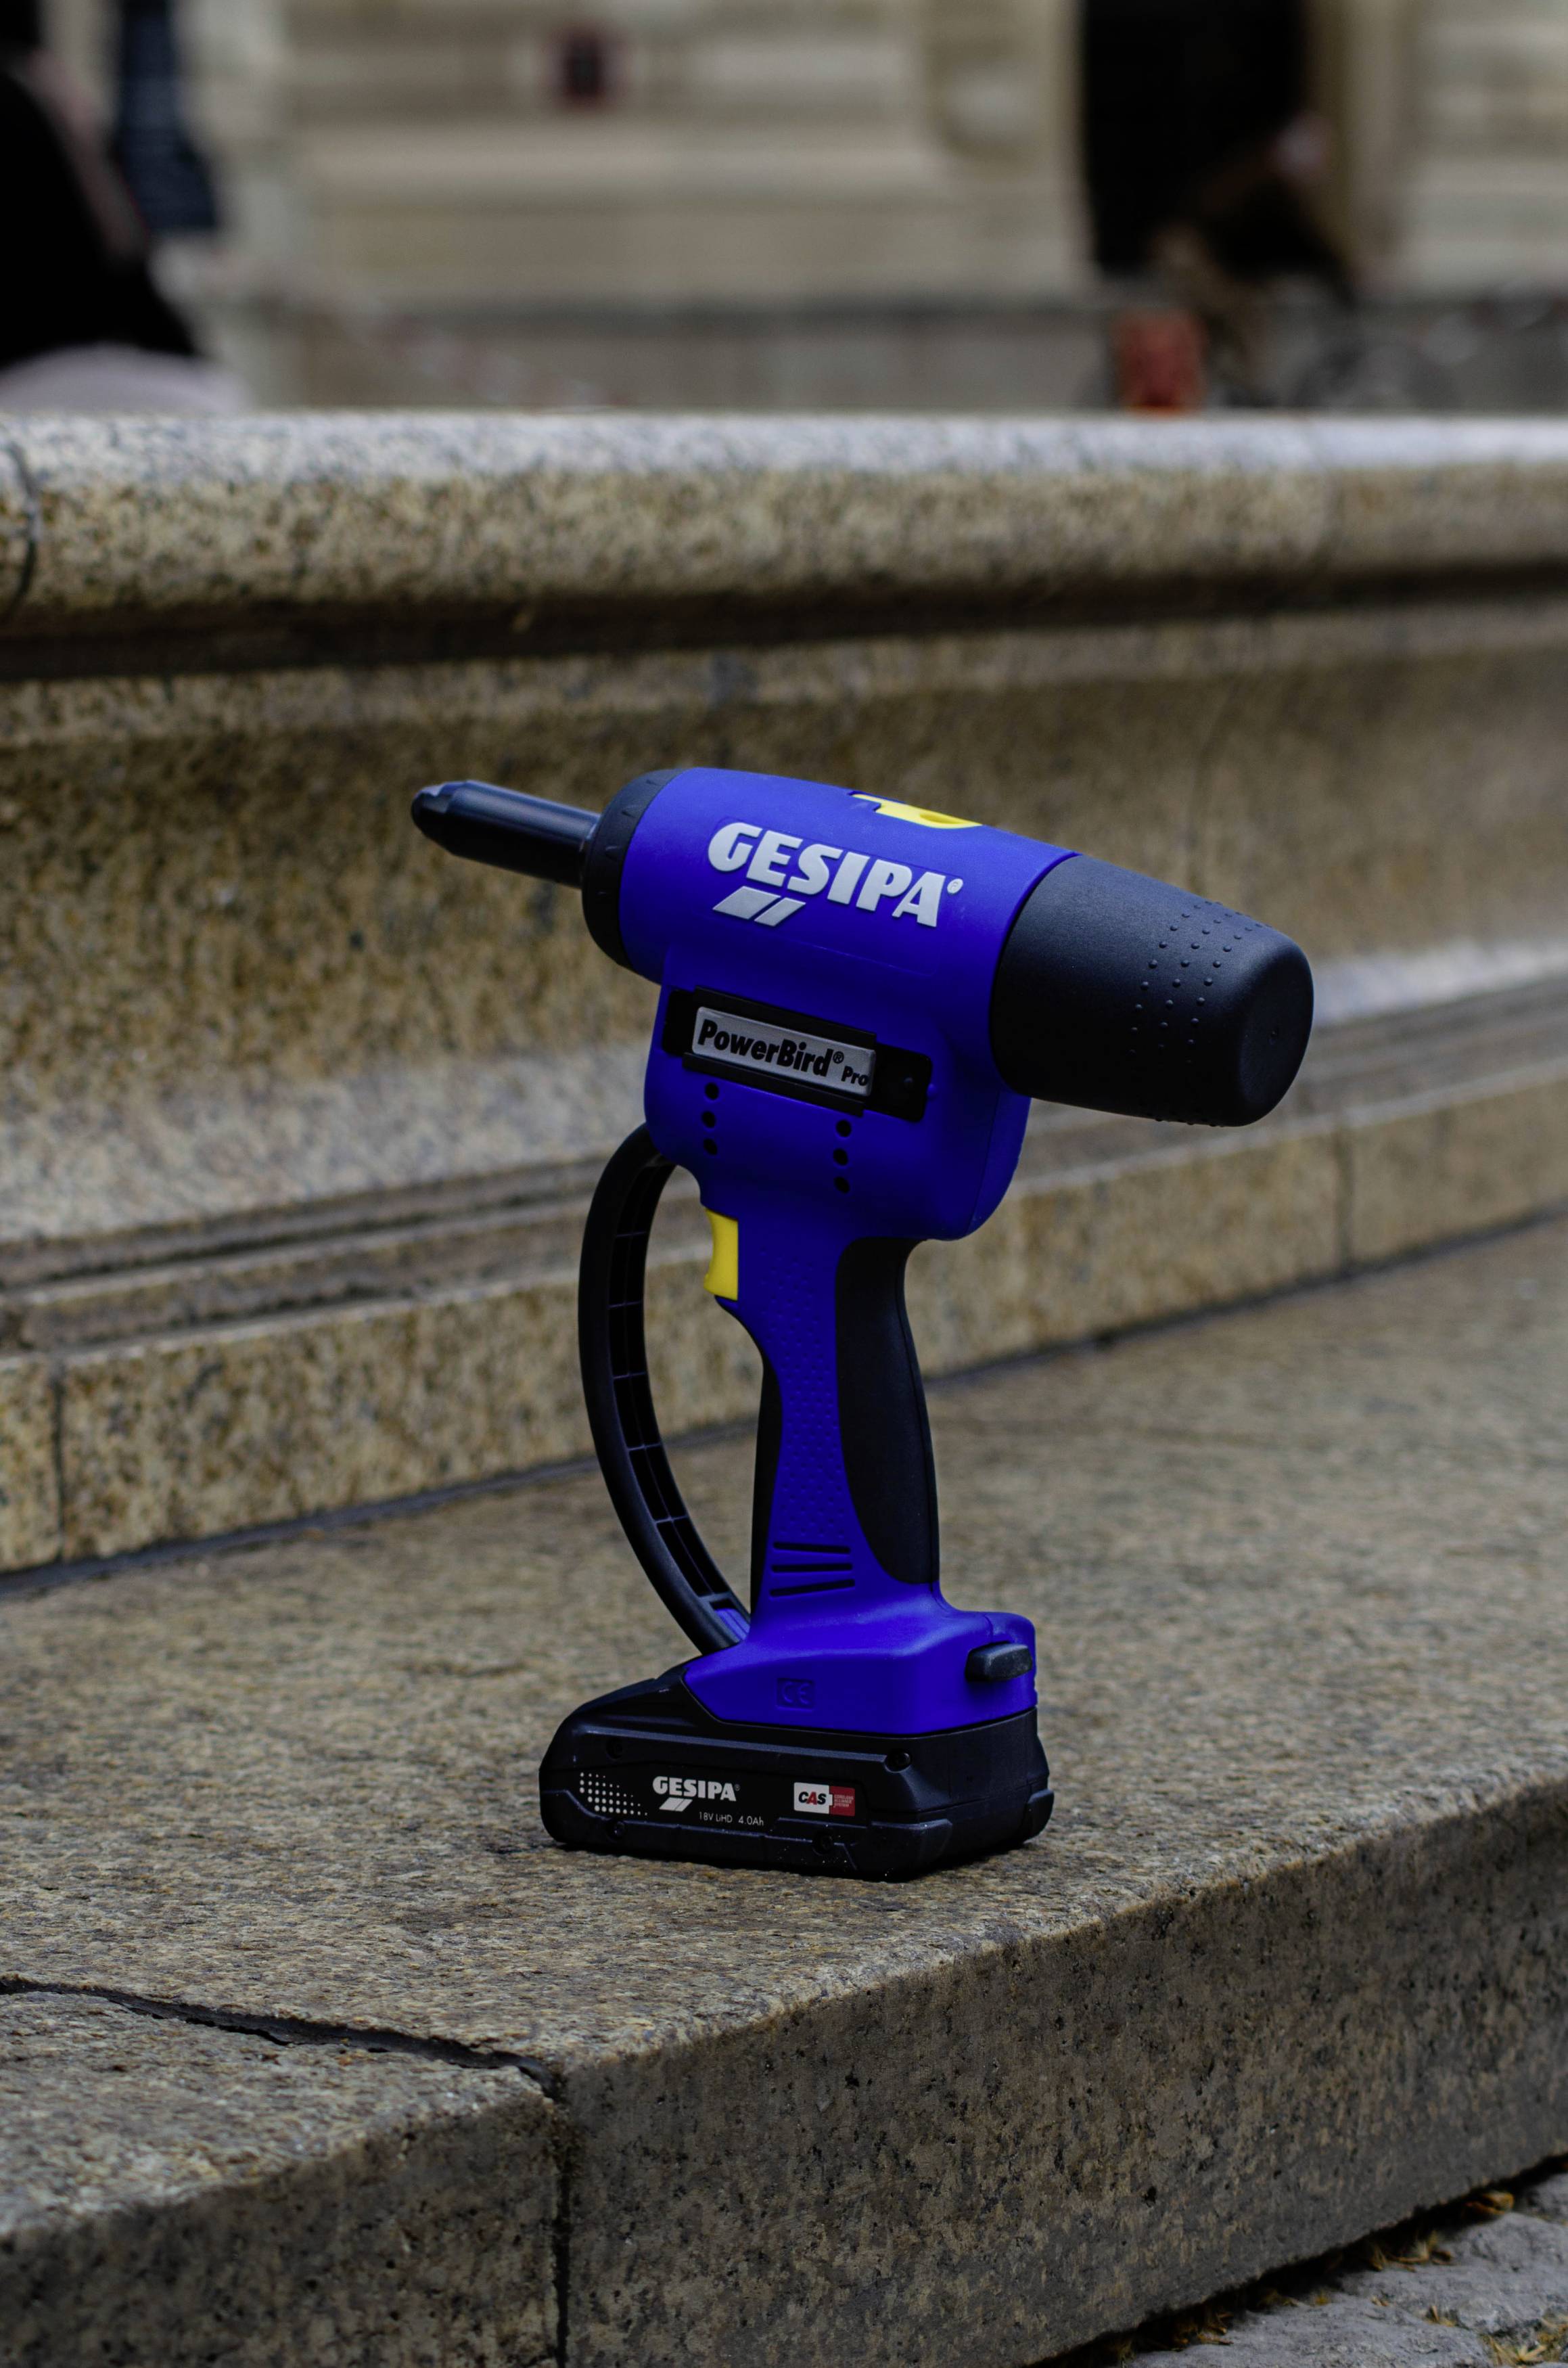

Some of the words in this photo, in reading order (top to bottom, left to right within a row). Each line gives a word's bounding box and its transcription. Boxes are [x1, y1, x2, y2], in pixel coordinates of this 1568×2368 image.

[841, 1066, 869, 1087] Pro
[798, 1791, 827, 1805] CAS
[699, 1811, 714, 1821] 18V
[738, 1815, 764, 1826] 4.0Ah
